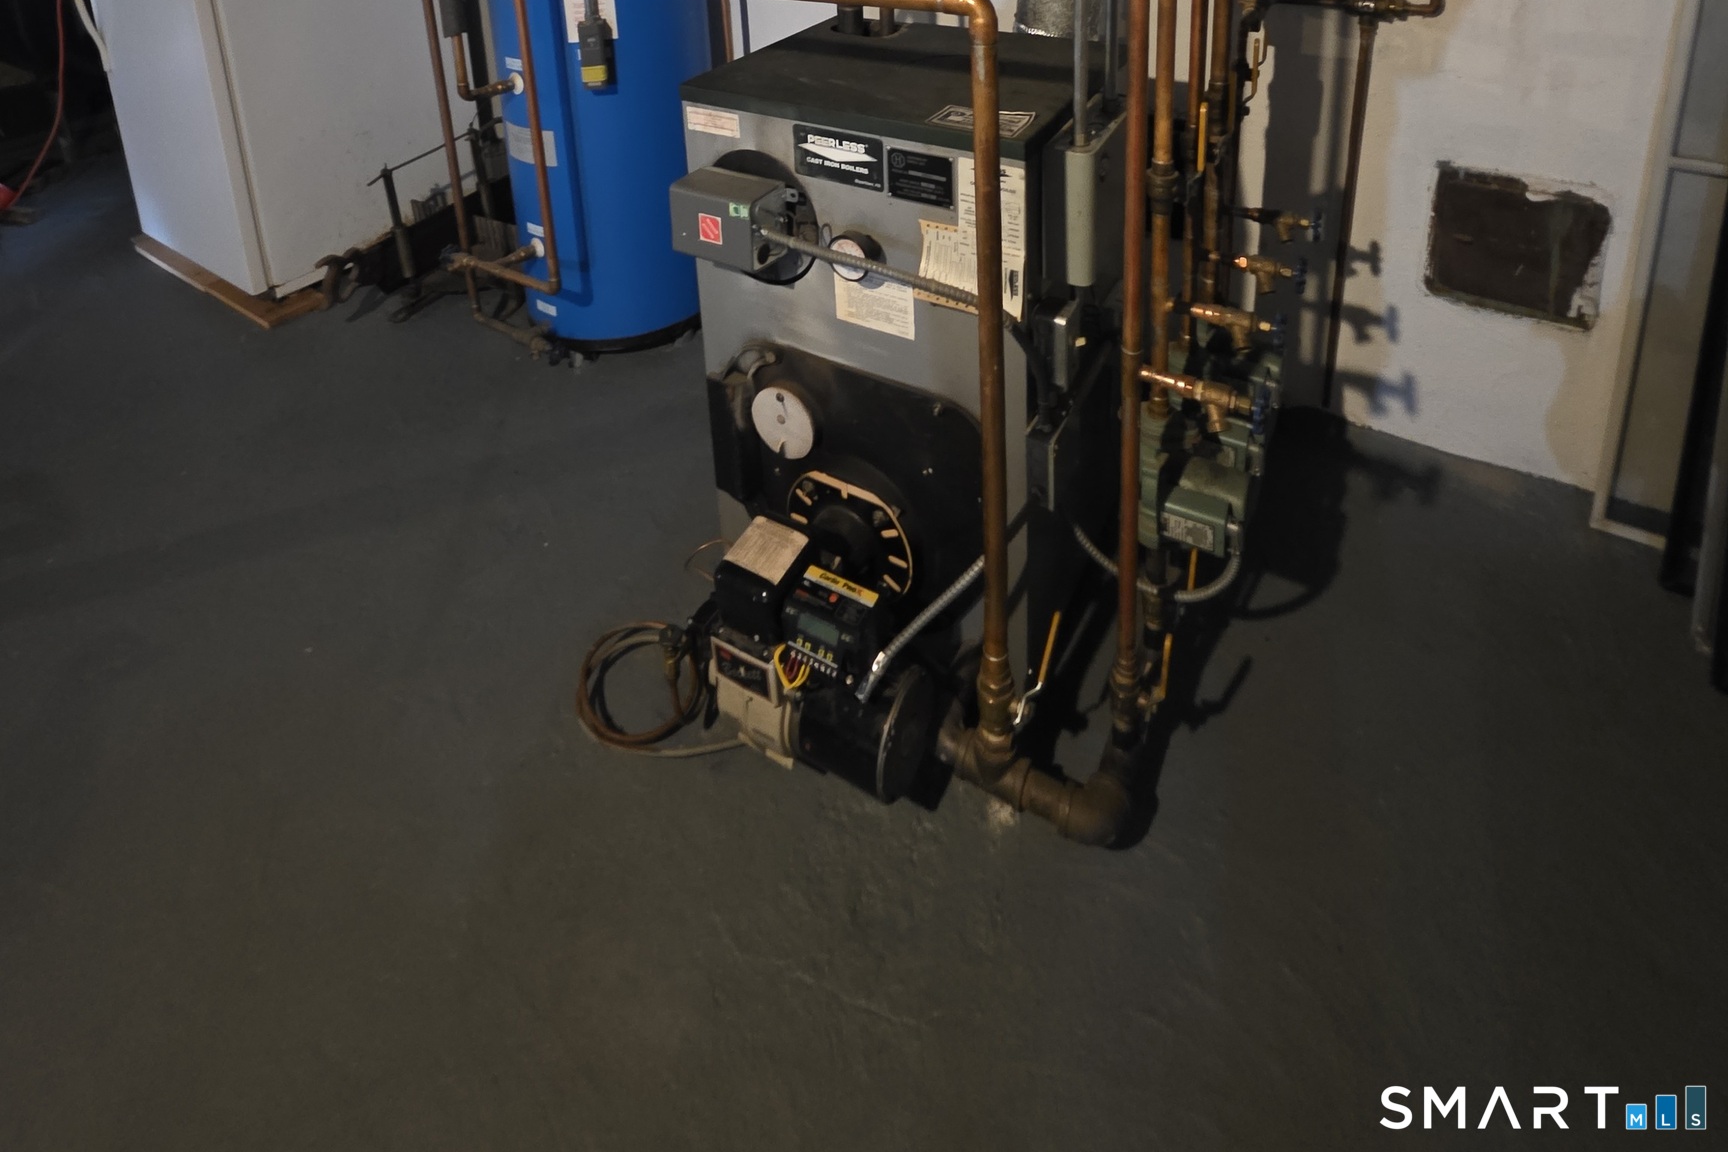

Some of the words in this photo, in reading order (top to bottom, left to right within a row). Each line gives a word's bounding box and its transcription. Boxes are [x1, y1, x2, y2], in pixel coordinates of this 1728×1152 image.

[807, 134, 866, 154] PEERLESS
[806, 156, 823, 165] CAST
[823, 160, 840, 168] IRON
[840, 163, 869, 175] BOILERS
